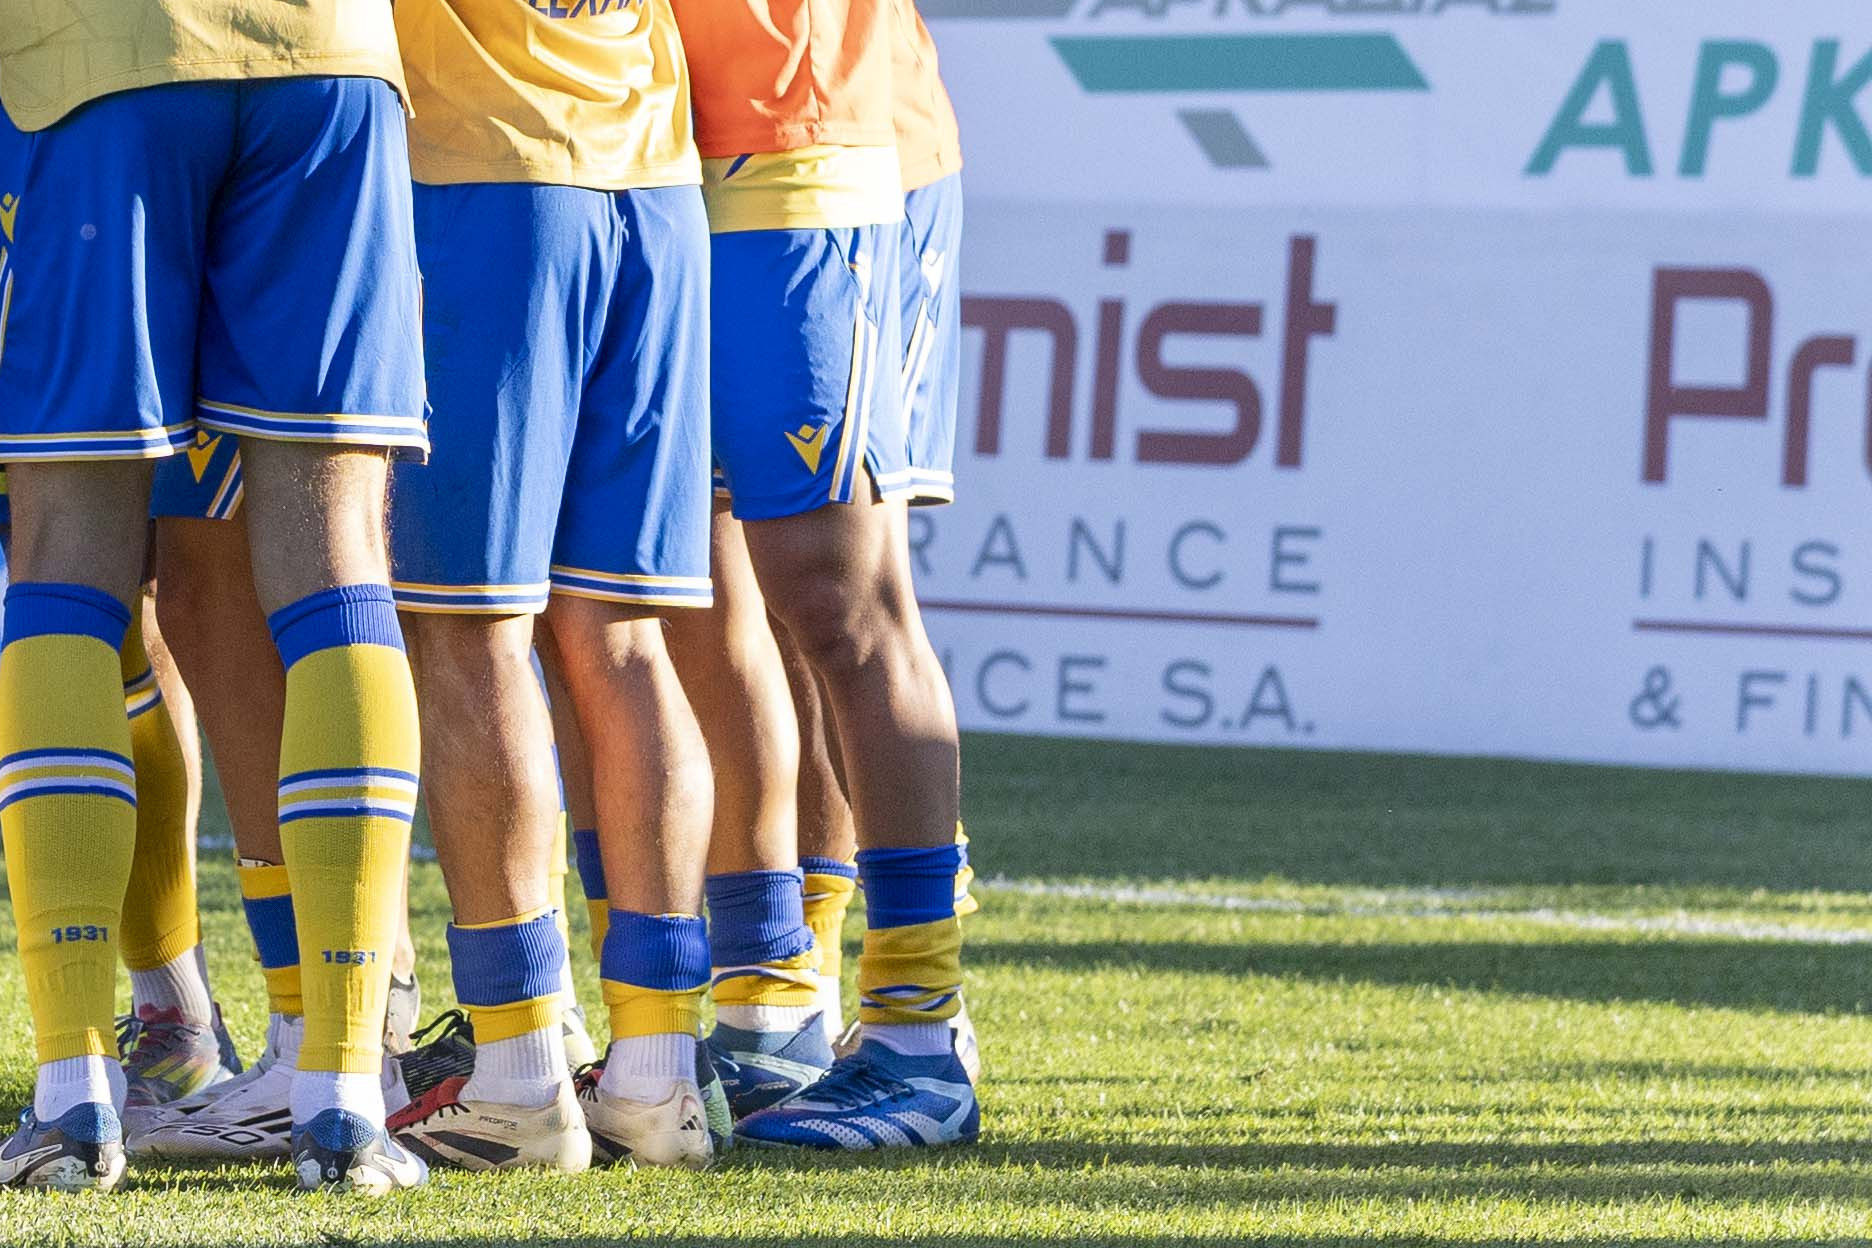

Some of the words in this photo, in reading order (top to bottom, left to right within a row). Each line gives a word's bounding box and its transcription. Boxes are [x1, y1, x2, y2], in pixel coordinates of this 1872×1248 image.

[1640, 265, 1872, 489] Pr
[943, 648, 1109, 722] CE
[1158, 657, 1319, 735] S.A.
[1627, 664, 1684, 732] &
[50, 924, 109, 945] 1931
[321, 949, 376, 966] 1931
